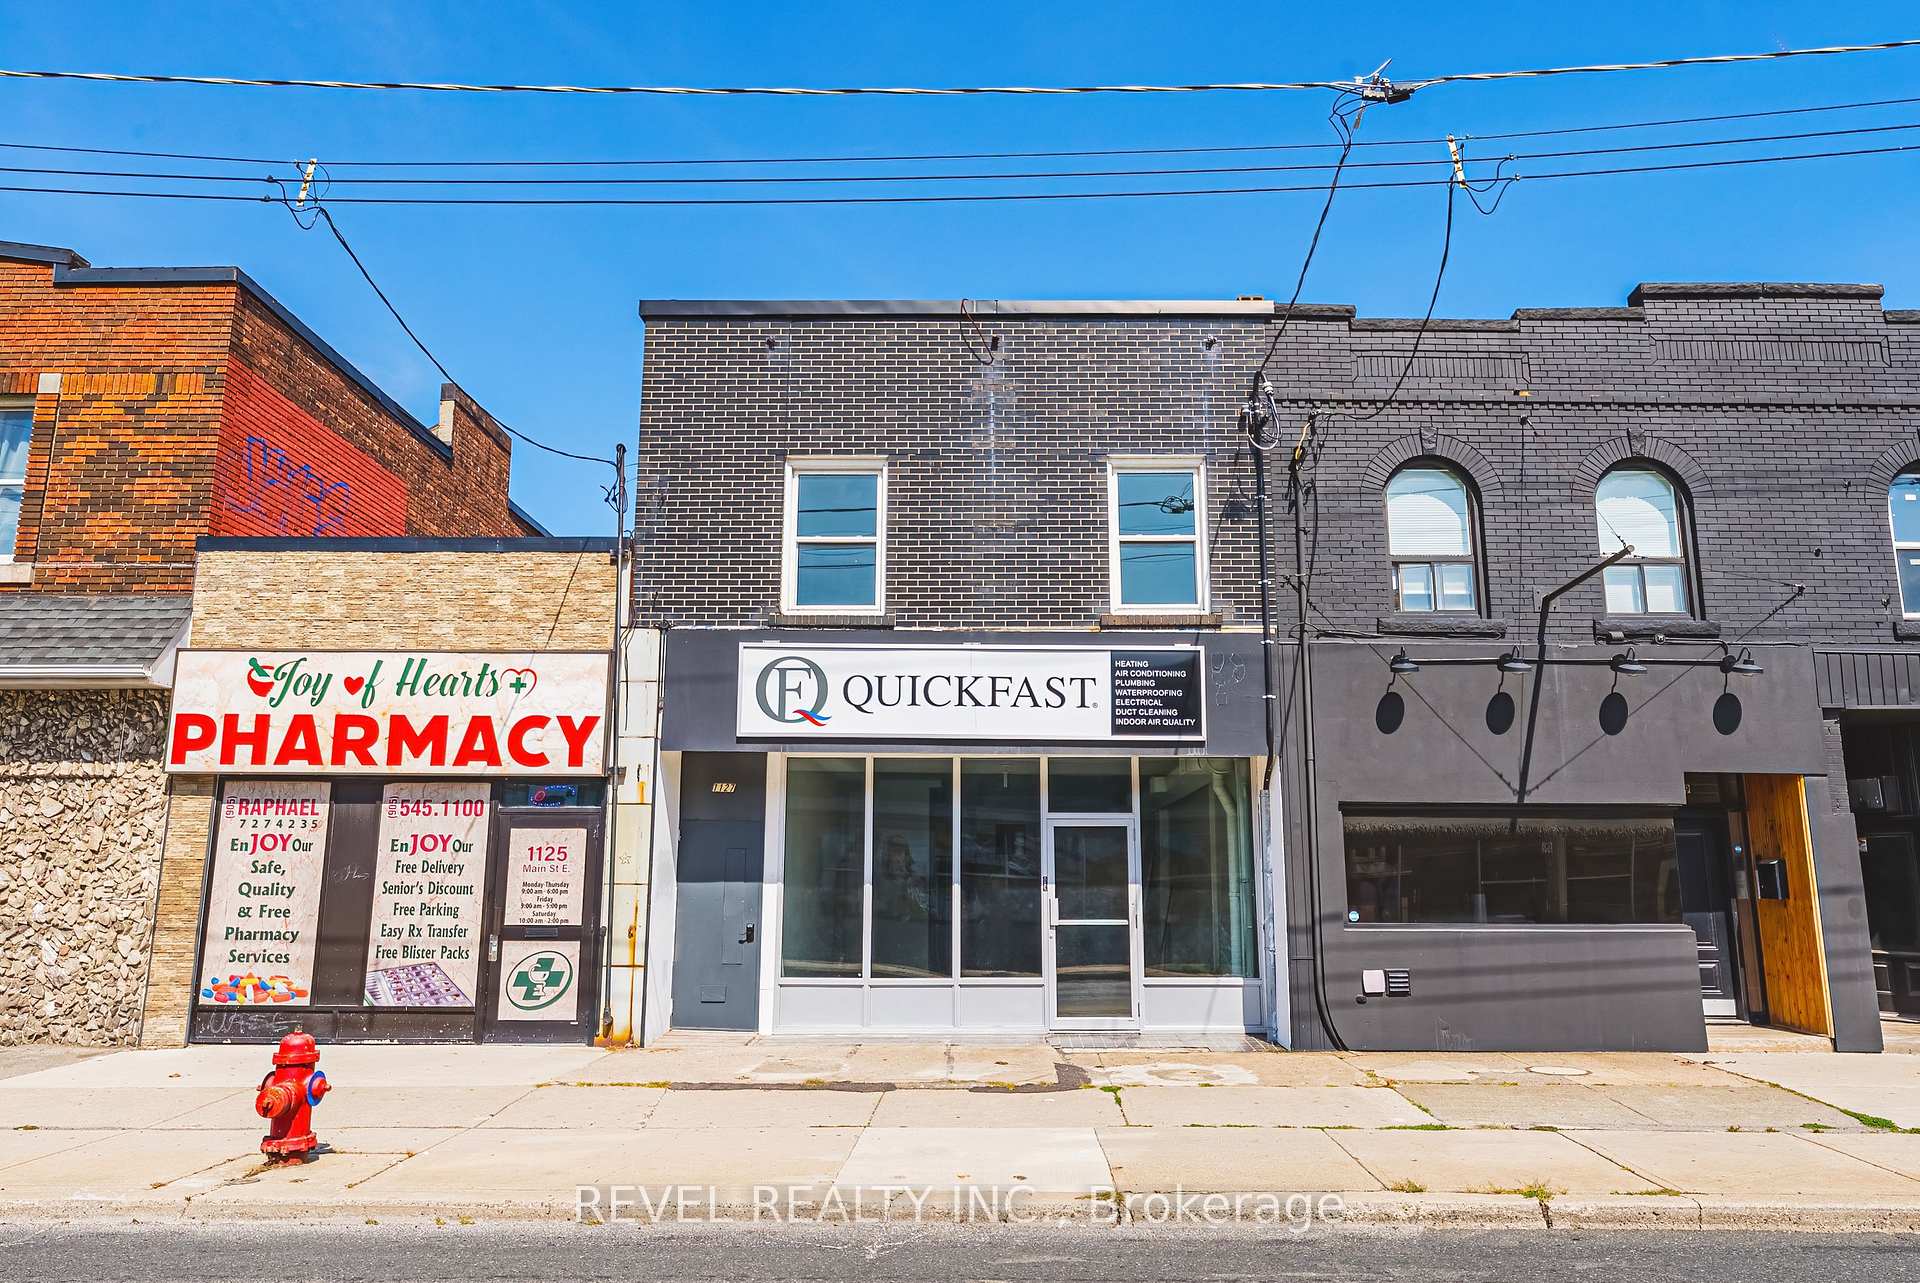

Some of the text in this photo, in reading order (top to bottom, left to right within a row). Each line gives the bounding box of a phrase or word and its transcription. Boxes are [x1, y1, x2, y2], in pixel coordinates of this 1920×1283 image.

[1115, 660, 1149, 668] HEATING
[269, 657, 333, 708] Joy
[396, 657, 501, 698] Hearts
[1115, 679, 1156, 687] PLUMBING
[1115, 689, 1183, 697] WATERPROOFING
[1115, 698, 1163, 706] ELECTRICAL
[1115, 708, 1178, 716] DUCT CLEANING
[1115, 718, 1196, 726] INDOOR AIR QUALITY
[171, 713, 600, 768] PHARMACY
[225, 796, 238, 819] (905)
[238, 798, 320, 816] RAPHAEL
[387, 796, 400, 819] (905)
[400, 799, 485, 817] 545.1100
[292, 838, 314, 852] Our
[452, 839, 473, 853] Our
[528, 846, 568, 862] 1125
[251, 860, 286, 876] Safe,
[395, 860, 465, 877] Free Delivery
[522, 864, 571, 873] Main St E.
[238, 882, 296, 899] Quality
[428, 881, 474, 895] Discount
[536, 896, 554, 904] Friday
[238, 904, 291, 918] & Free
[393, 902, 460, 919] Free Parking
[532, 910, 556, 918] Saturday
[224, 926, 300, 944] Pharmacy
[380, 923, 469, 940] Easy Rx Transfer
[228, 949, 290, 963] Services
[375, 945, 470, 960] Free Blister Packs
